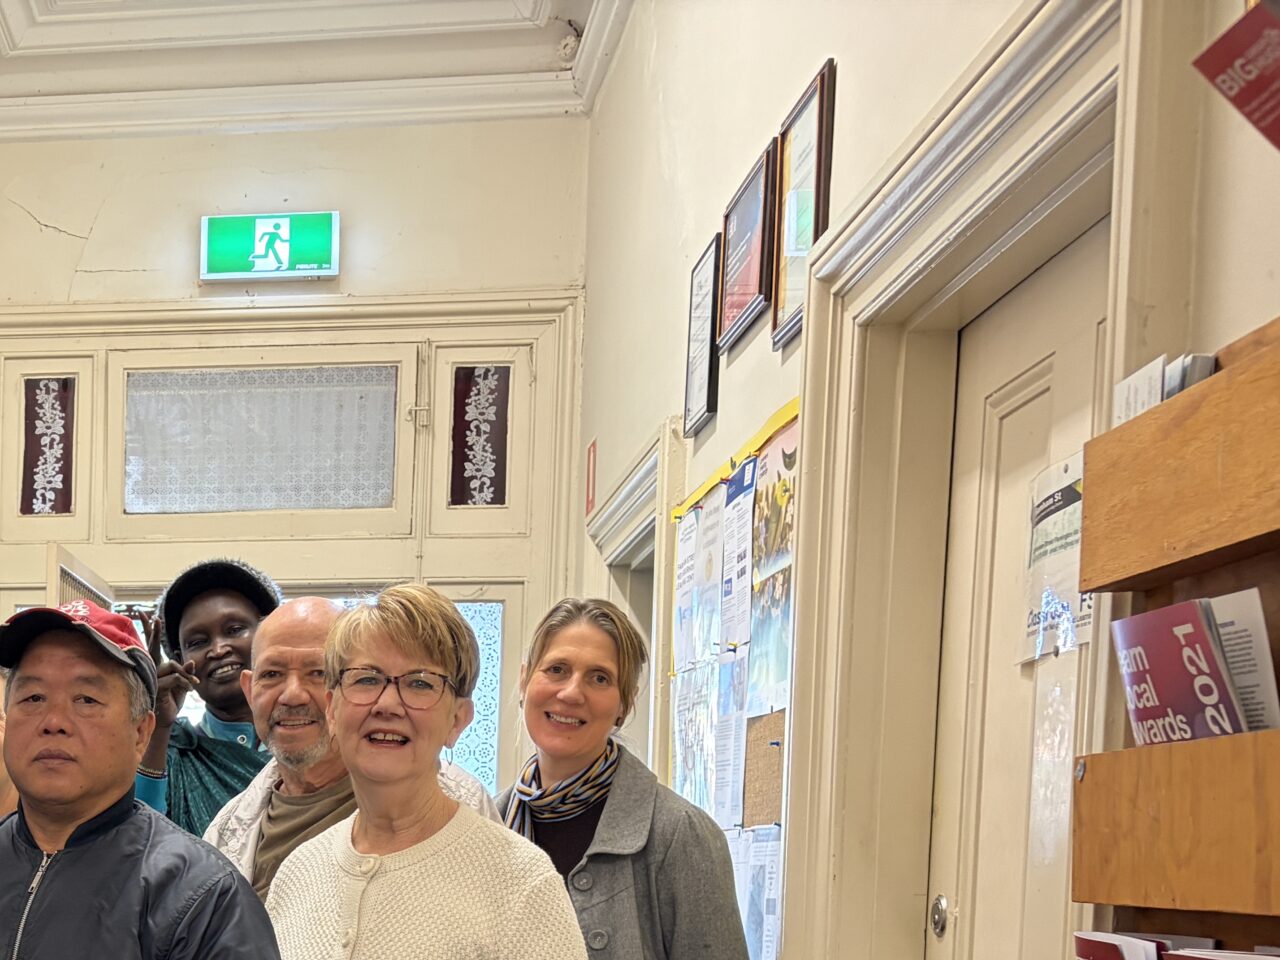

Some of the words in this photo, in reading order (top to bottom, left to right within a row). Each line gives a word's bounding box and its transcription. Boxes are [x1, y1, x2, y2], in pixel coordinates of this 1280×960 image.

[1215, 57, 1261, 97] BIG
[1127, 674, 1160, 709] ocal
[1172, 623, 1233, 734] 2021
[1135, 708, 1192, 745] wards
